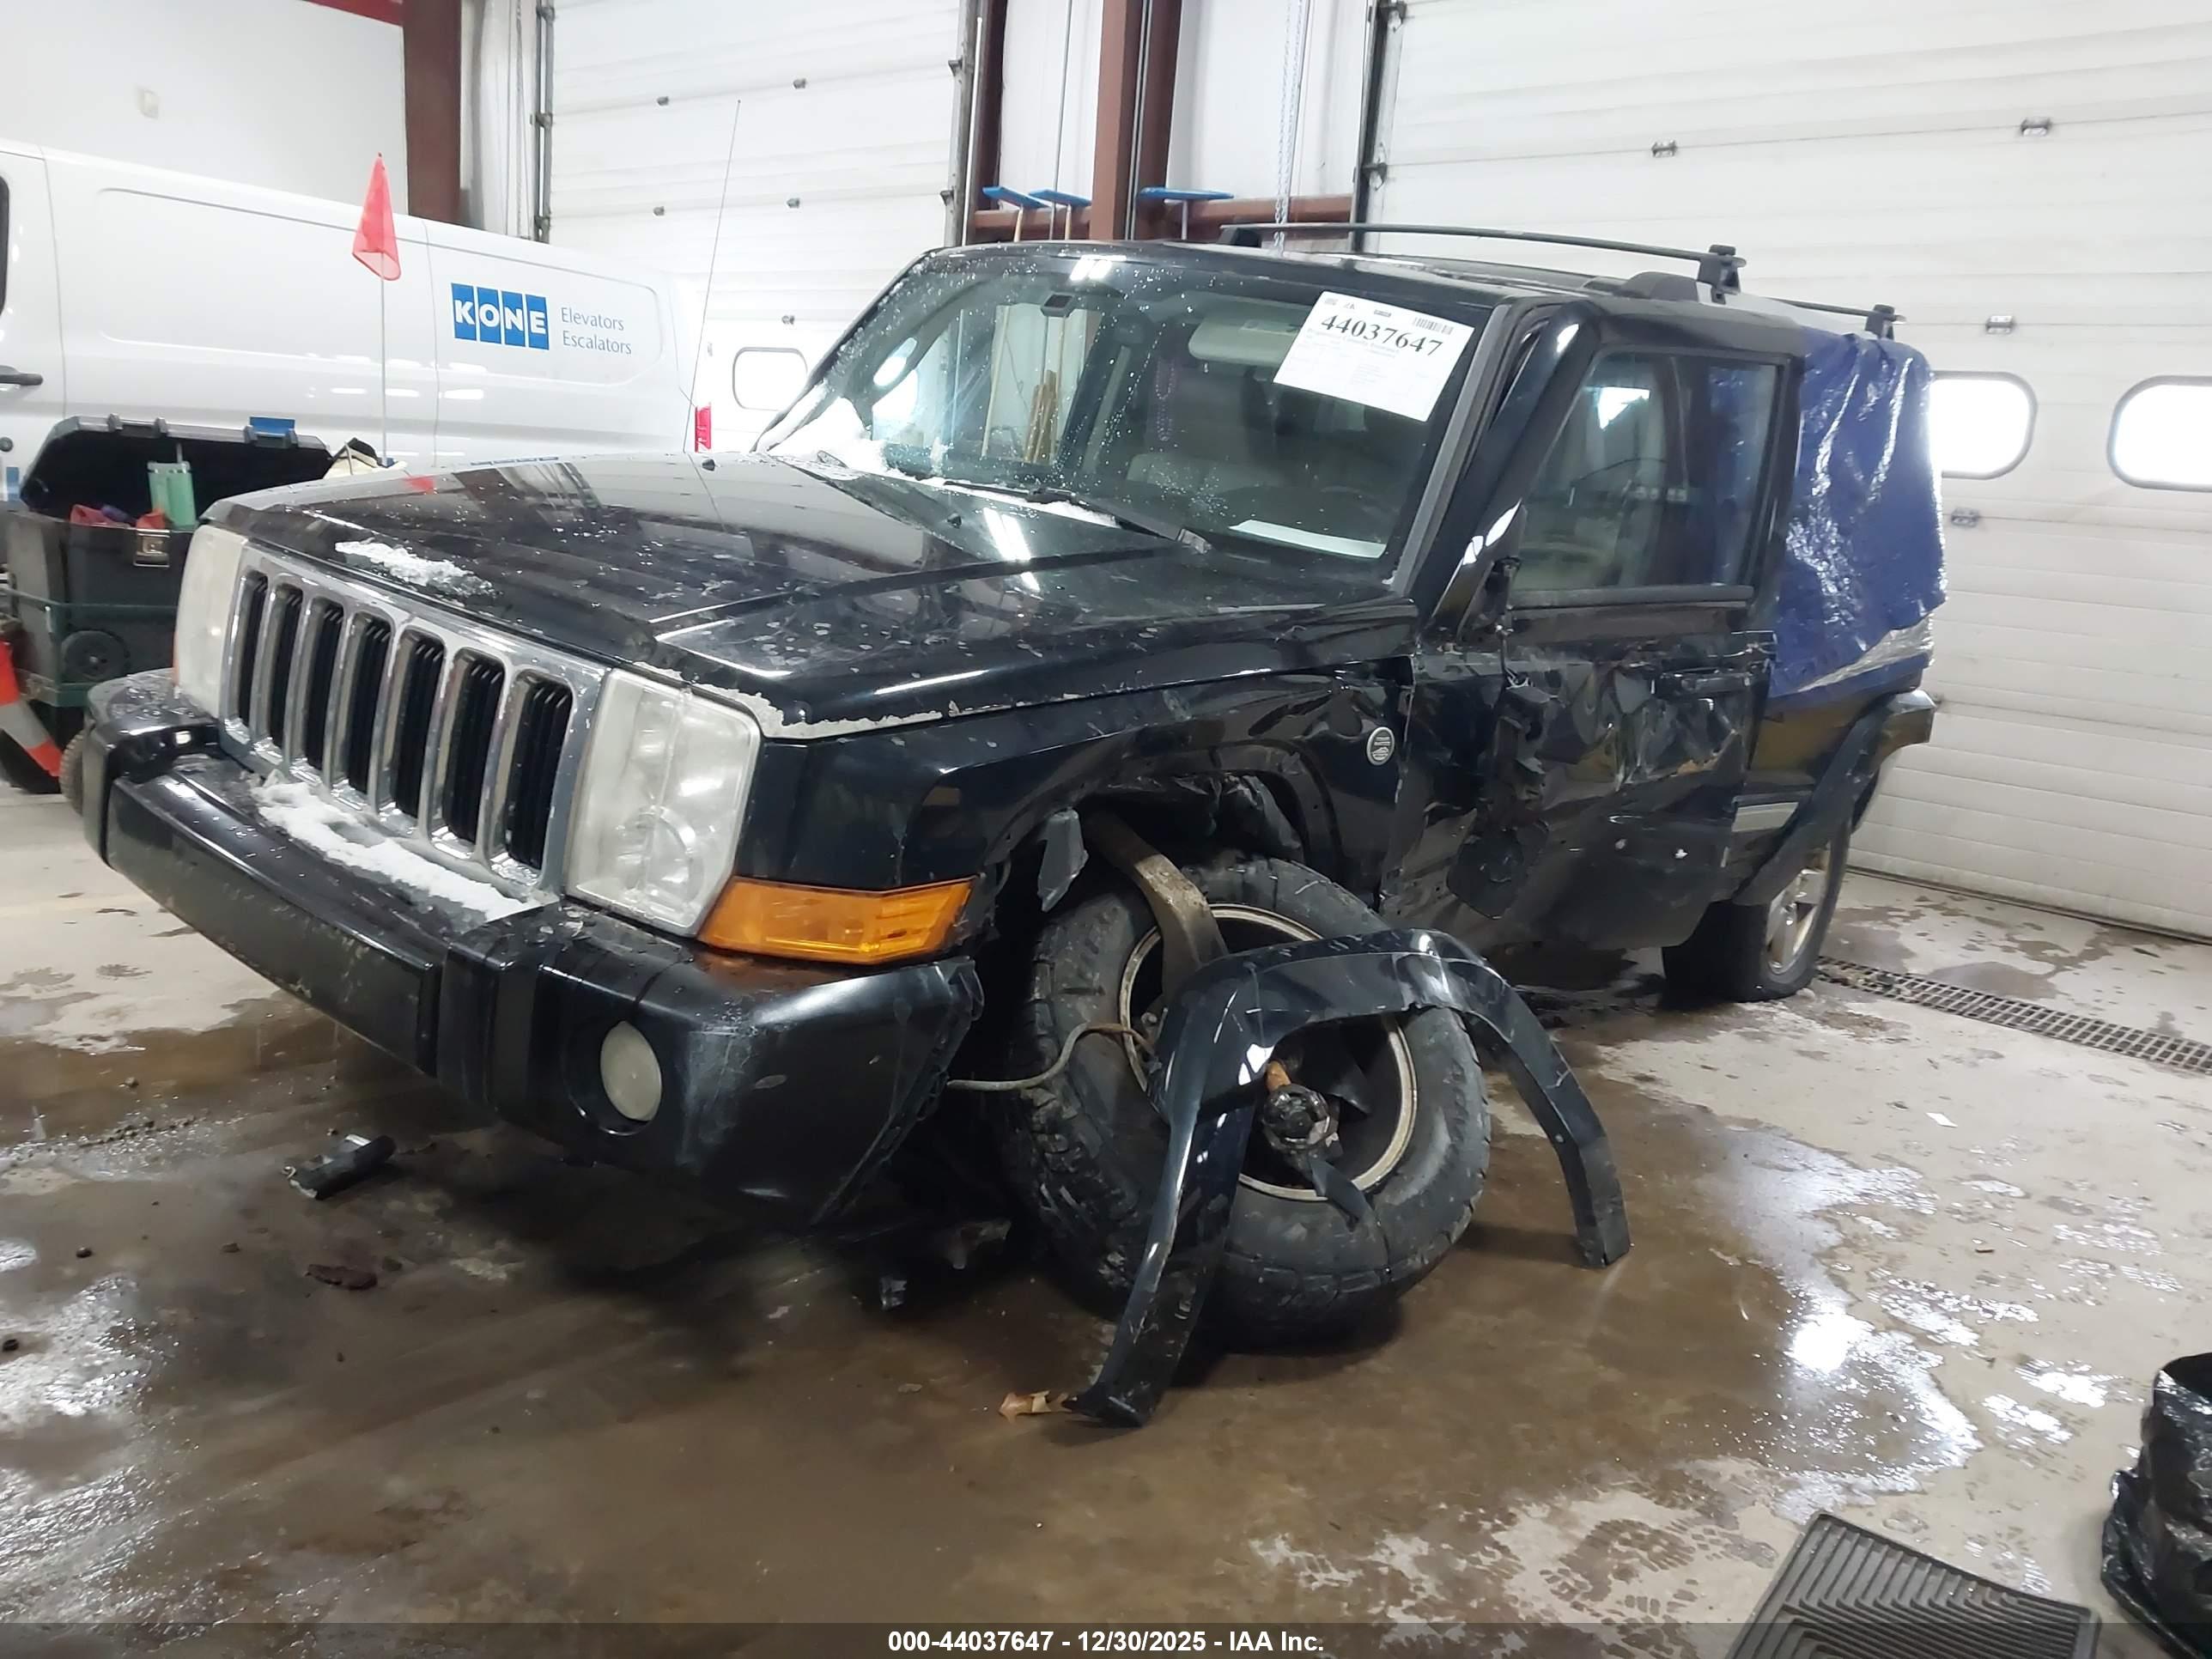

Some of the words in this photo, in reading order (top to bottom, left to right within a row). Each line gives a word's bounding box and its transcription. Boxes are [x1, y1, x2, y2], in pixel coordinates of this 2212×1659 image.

[454, 300, 546, 334] KONE
[561, 307, 624, 331] Elevators
[562, 330, 632, 355] Escalators
[1322, 315, 1443, 356] 44037647
